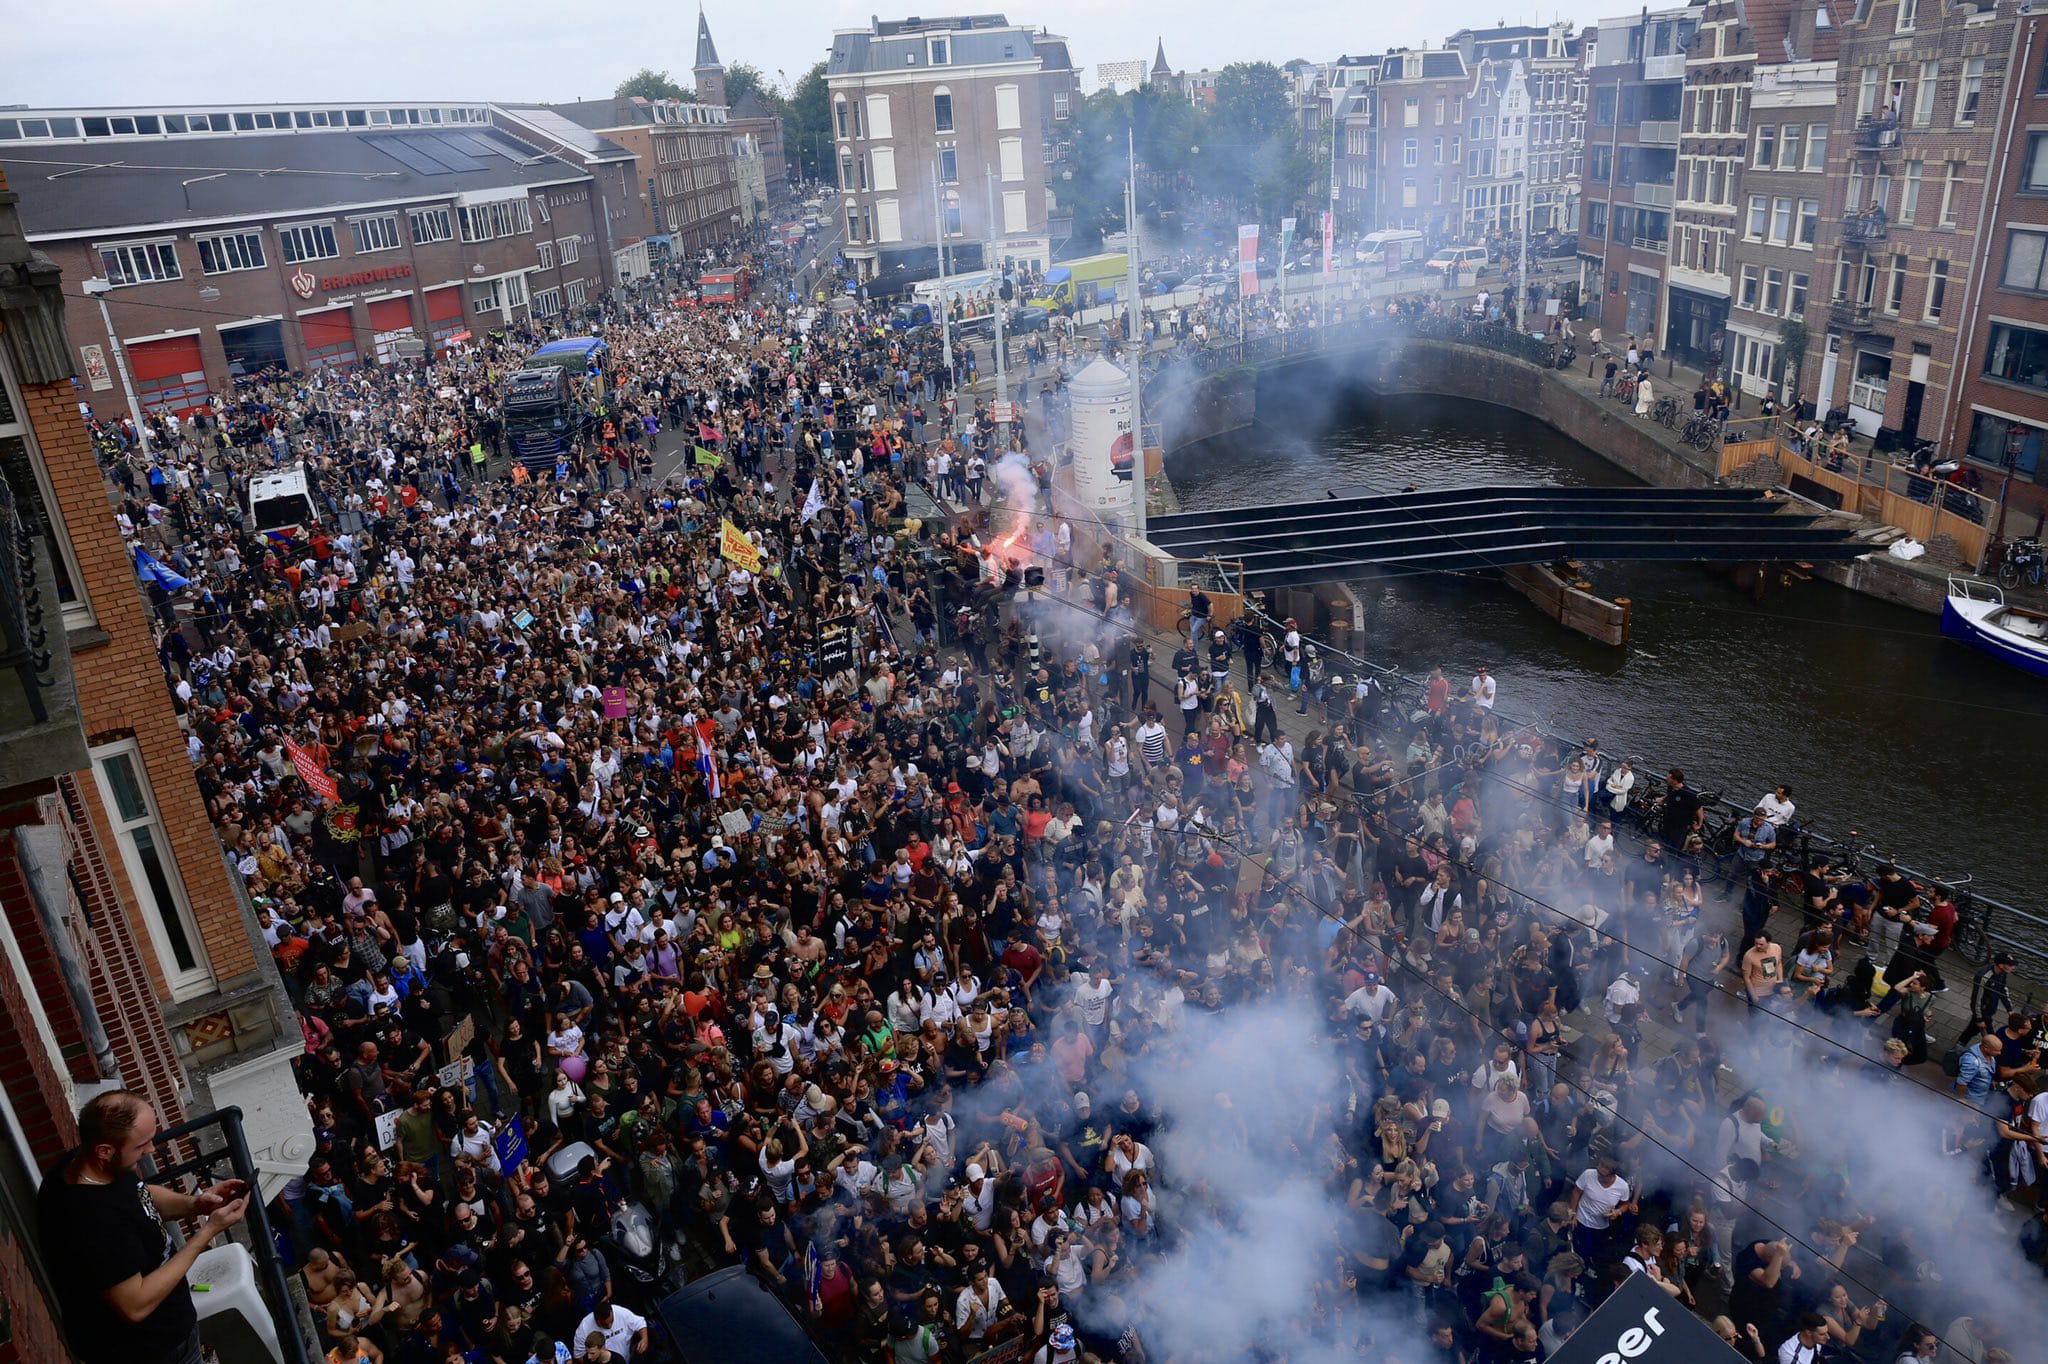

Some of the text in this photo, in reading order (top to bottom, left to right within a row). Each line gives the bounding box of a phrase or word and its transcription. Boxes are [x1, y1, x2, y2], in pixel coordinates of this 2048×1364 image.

[320, 264, 413, 291] BRANDWEER
[328, 294, 357, 302] Amsterdam
[360, 287, 387, 297] Amstelland
